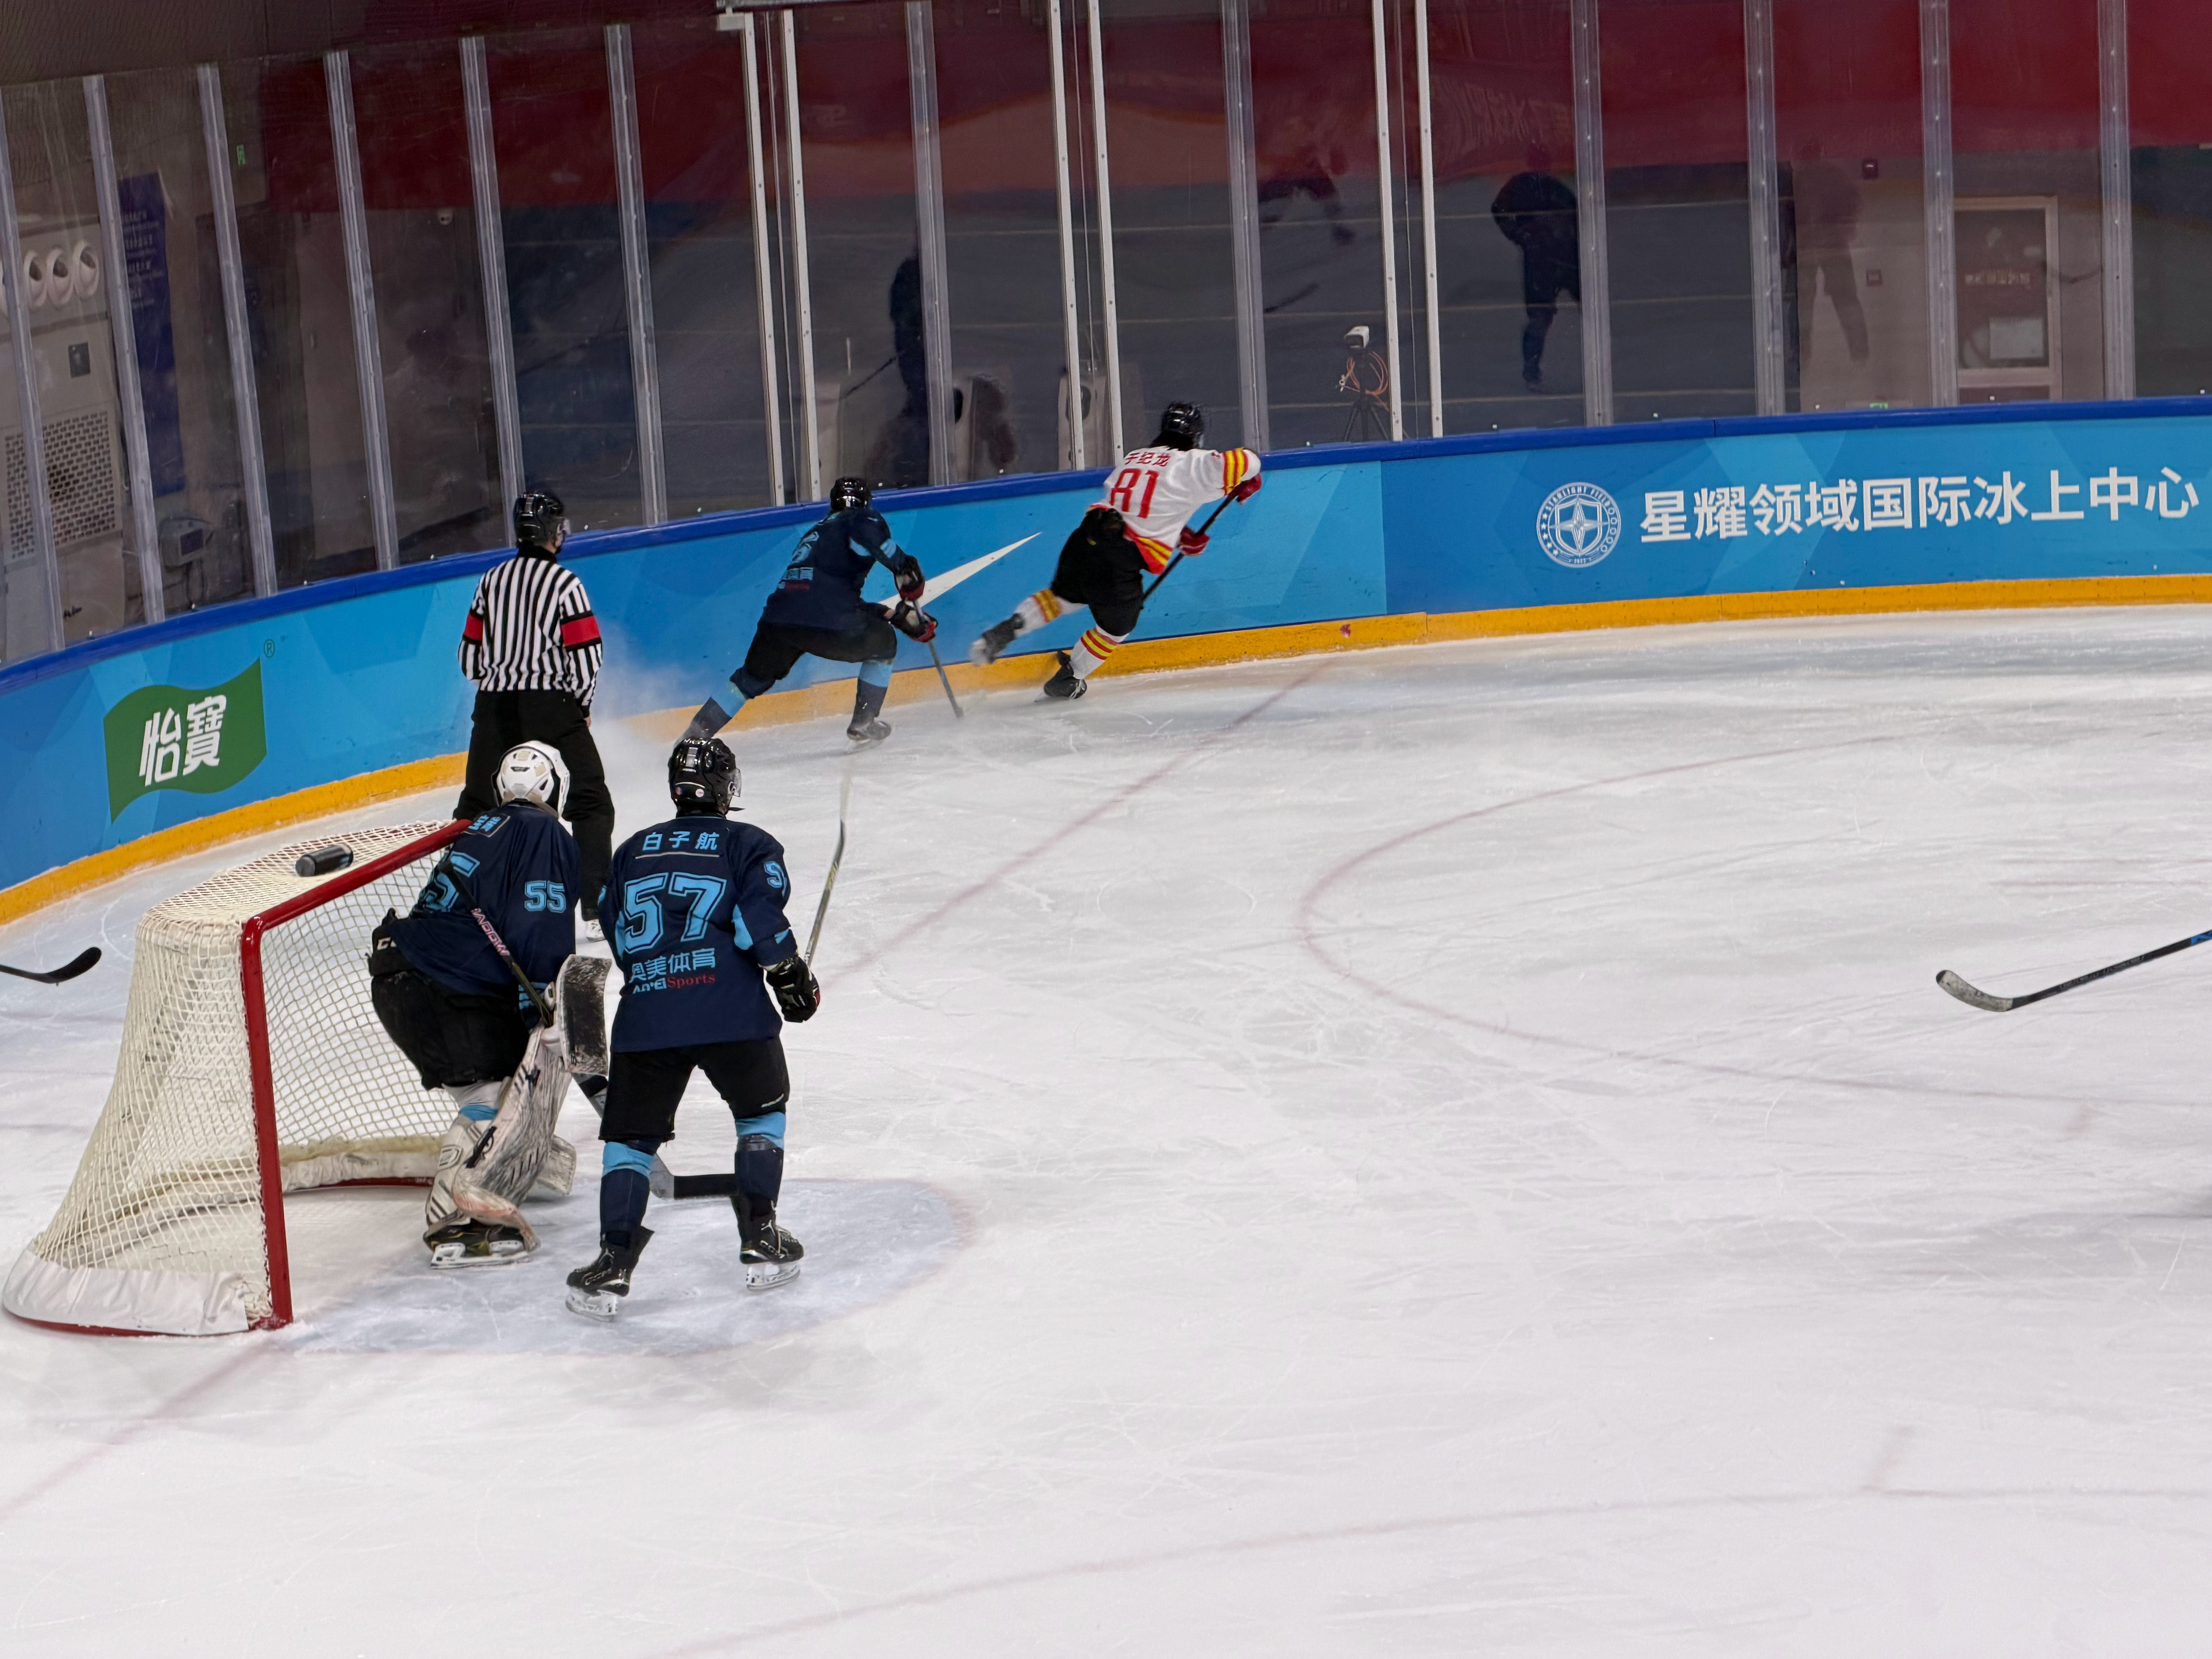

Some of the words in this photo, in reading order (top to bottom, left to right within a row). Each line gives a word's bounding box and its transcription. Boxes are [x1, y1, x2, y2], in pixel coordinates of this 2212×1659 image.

[1640, 466, 2199, 542] 星耀领域国际冰上中心
[139, 695, 227, 787] 怡寶
[642, 831, 720, 851] 白子航
[524, 880, 567, 913] 55
[623, 872, 727, 954] 57
[629, 948, 716, 983] 奥美体育
[667, 973, 715, 989] Sports
